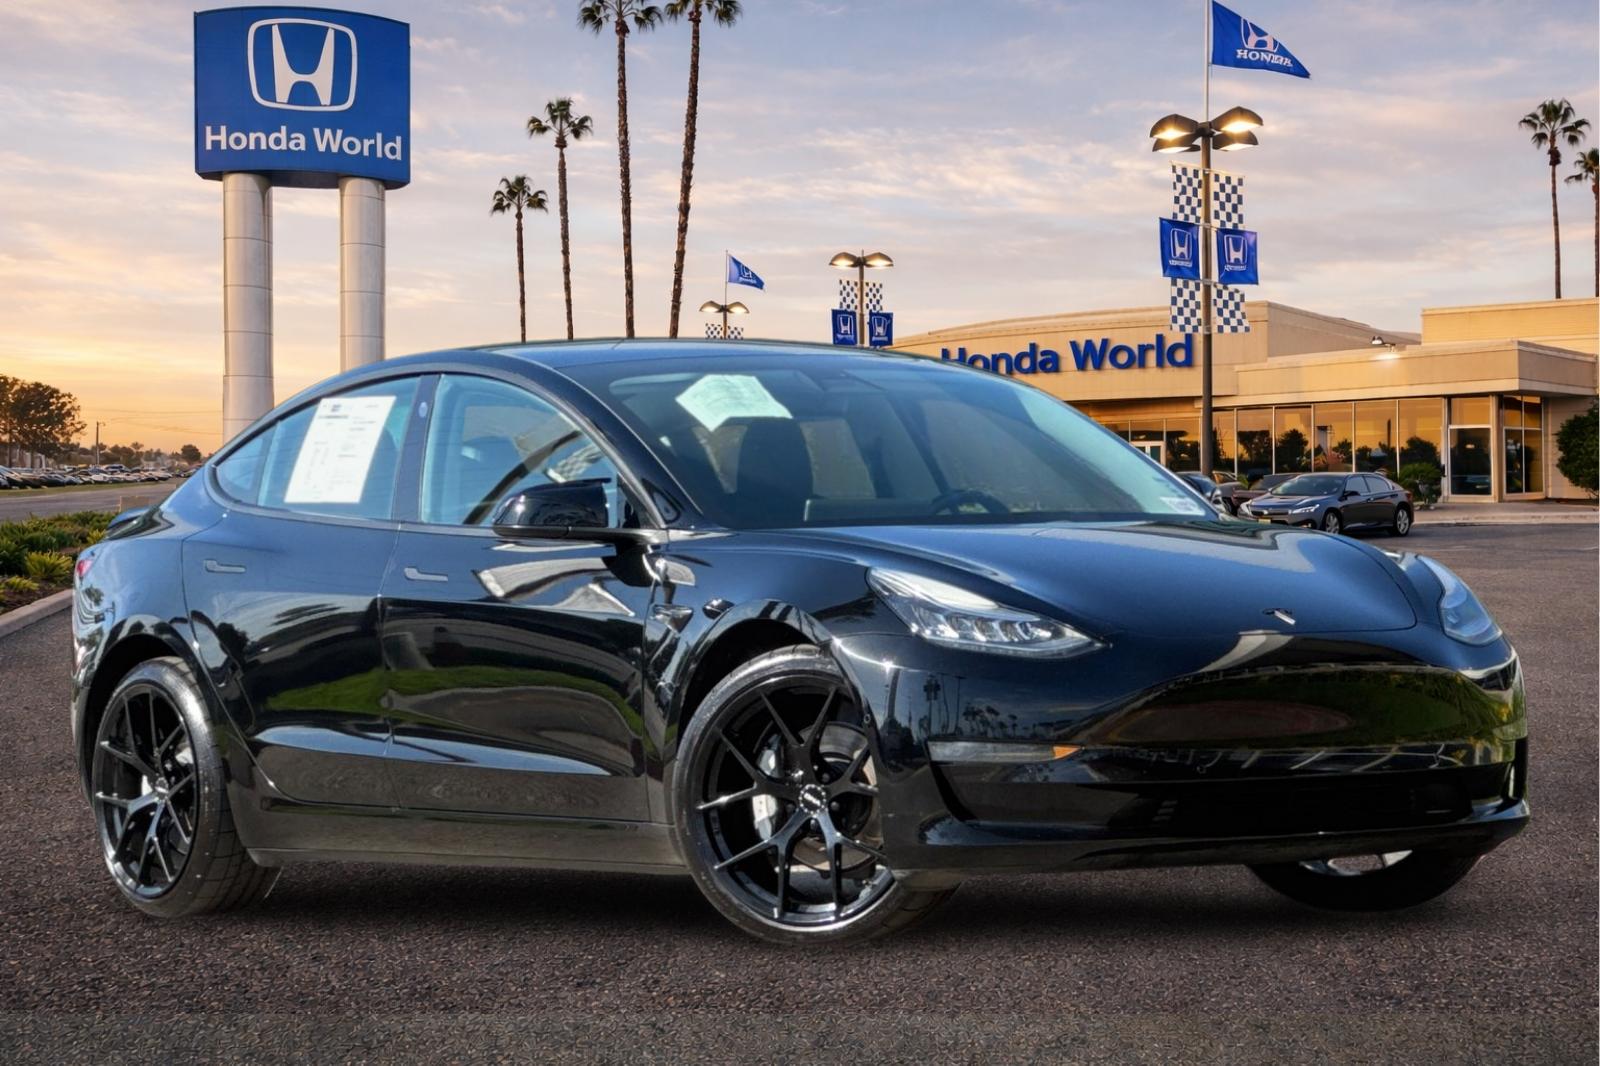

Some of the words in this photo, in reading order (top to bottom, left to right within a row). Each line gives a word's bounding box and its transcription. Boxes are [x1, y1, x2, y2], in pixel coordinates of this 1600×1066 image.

[205, 125, 306, 151] Honda
[313, 127, 402, 161] World
[1069, 333, 1194, 371] World
